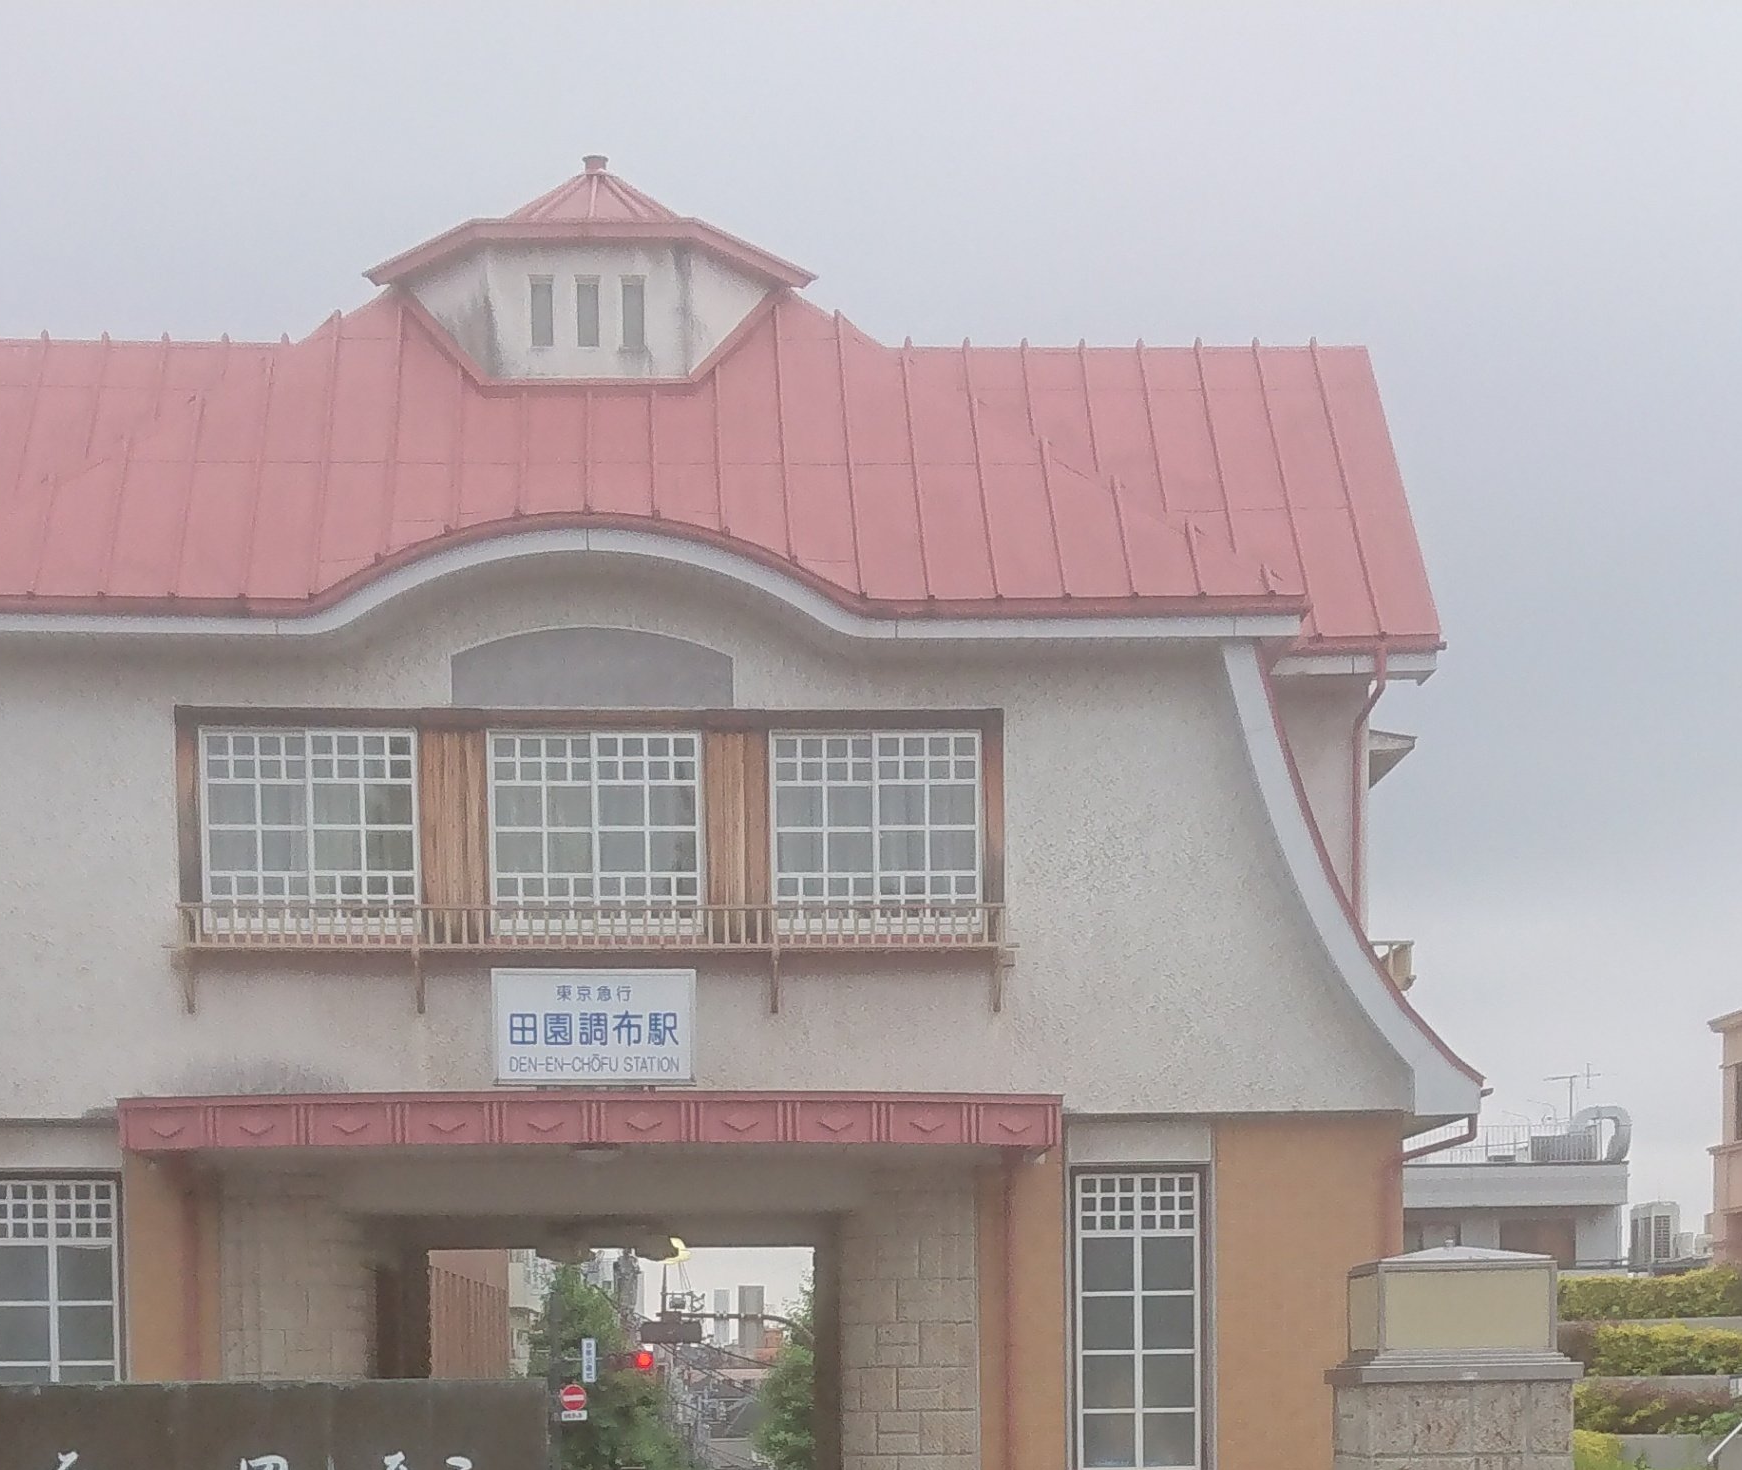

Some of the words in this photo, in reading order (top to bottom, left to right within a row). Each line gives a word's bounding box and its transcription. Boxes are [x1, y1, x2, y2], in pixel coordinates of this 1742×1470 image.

[556, 985, 632, 1002] 東京急行
[509, 1010, 679, 1046] 田園調布駅
[623, 1056, 680, 1072] STATION
